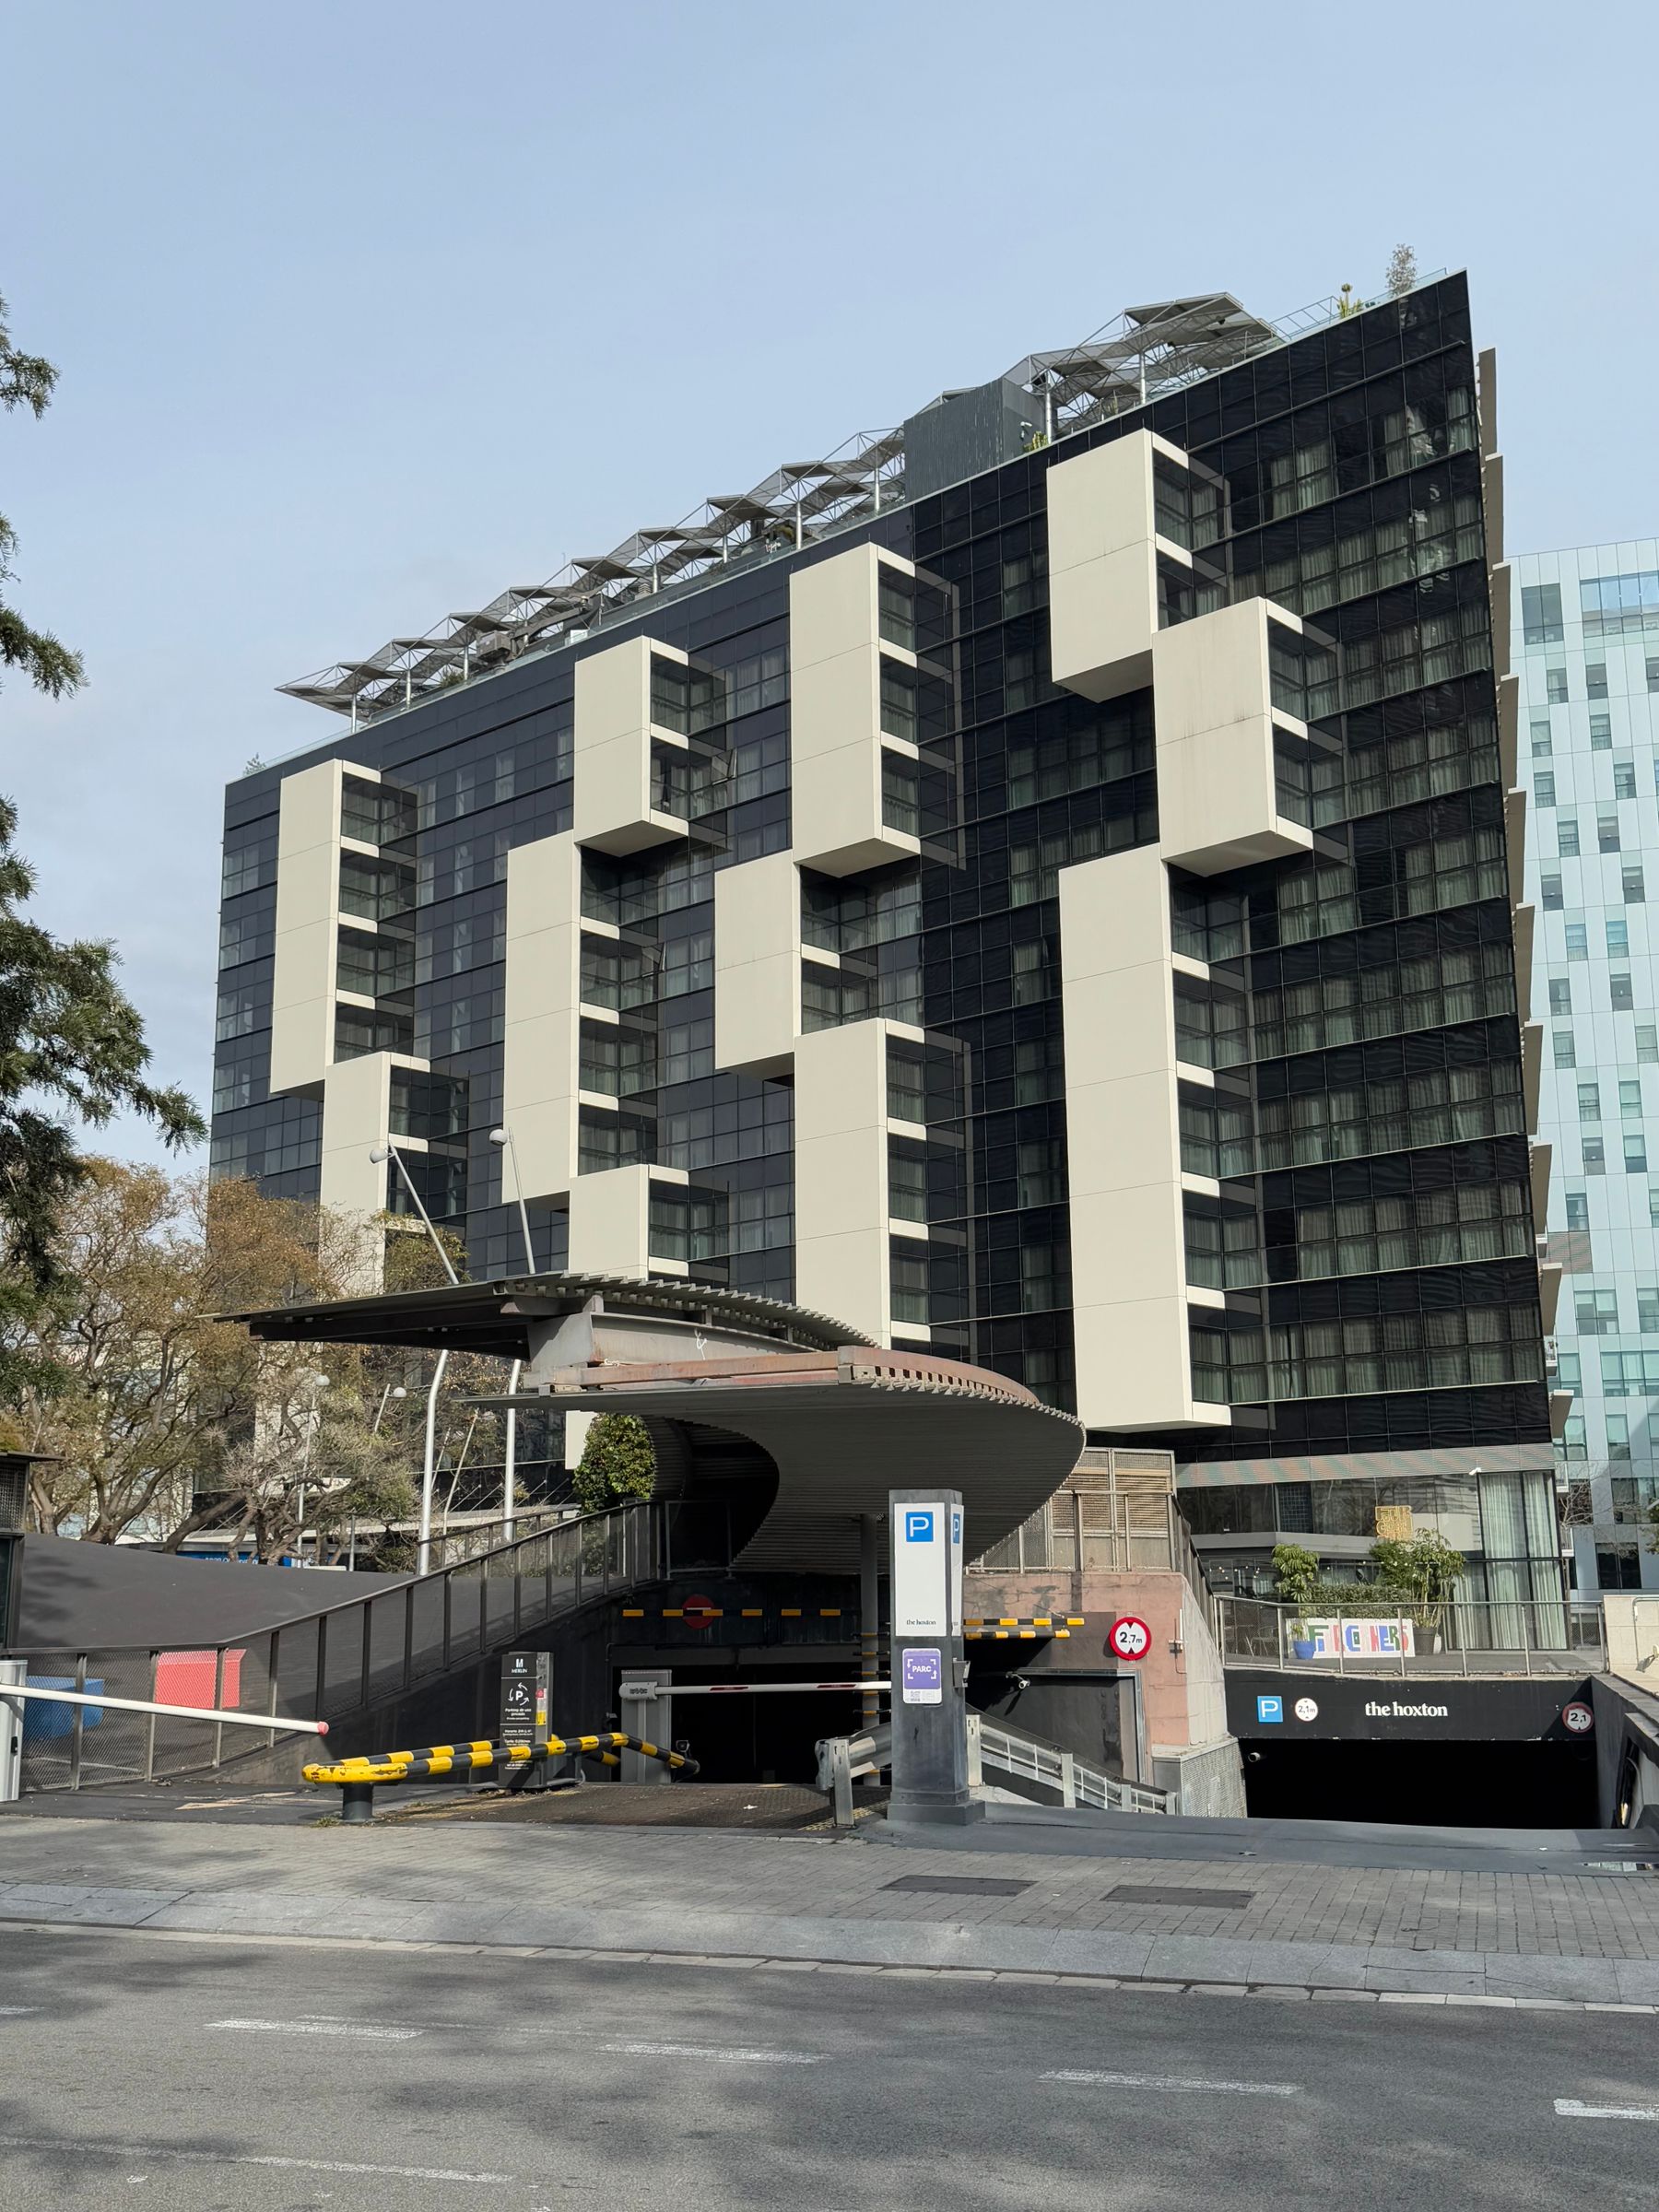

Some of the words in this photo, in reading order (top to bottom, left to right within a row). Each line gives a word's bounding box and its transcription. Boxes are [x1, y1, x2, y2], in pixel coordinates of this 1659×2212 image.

[910, 1517, 929, 1537] P
[515, 1690, 524, 1700] P
[1262, 1700, 1278, 1718] P
[1365, 1701, 1391, 1716] the
[1393, 1701, 1448, 1716] hoxton
[1571, 1712, 1586, 1723] 2,1
